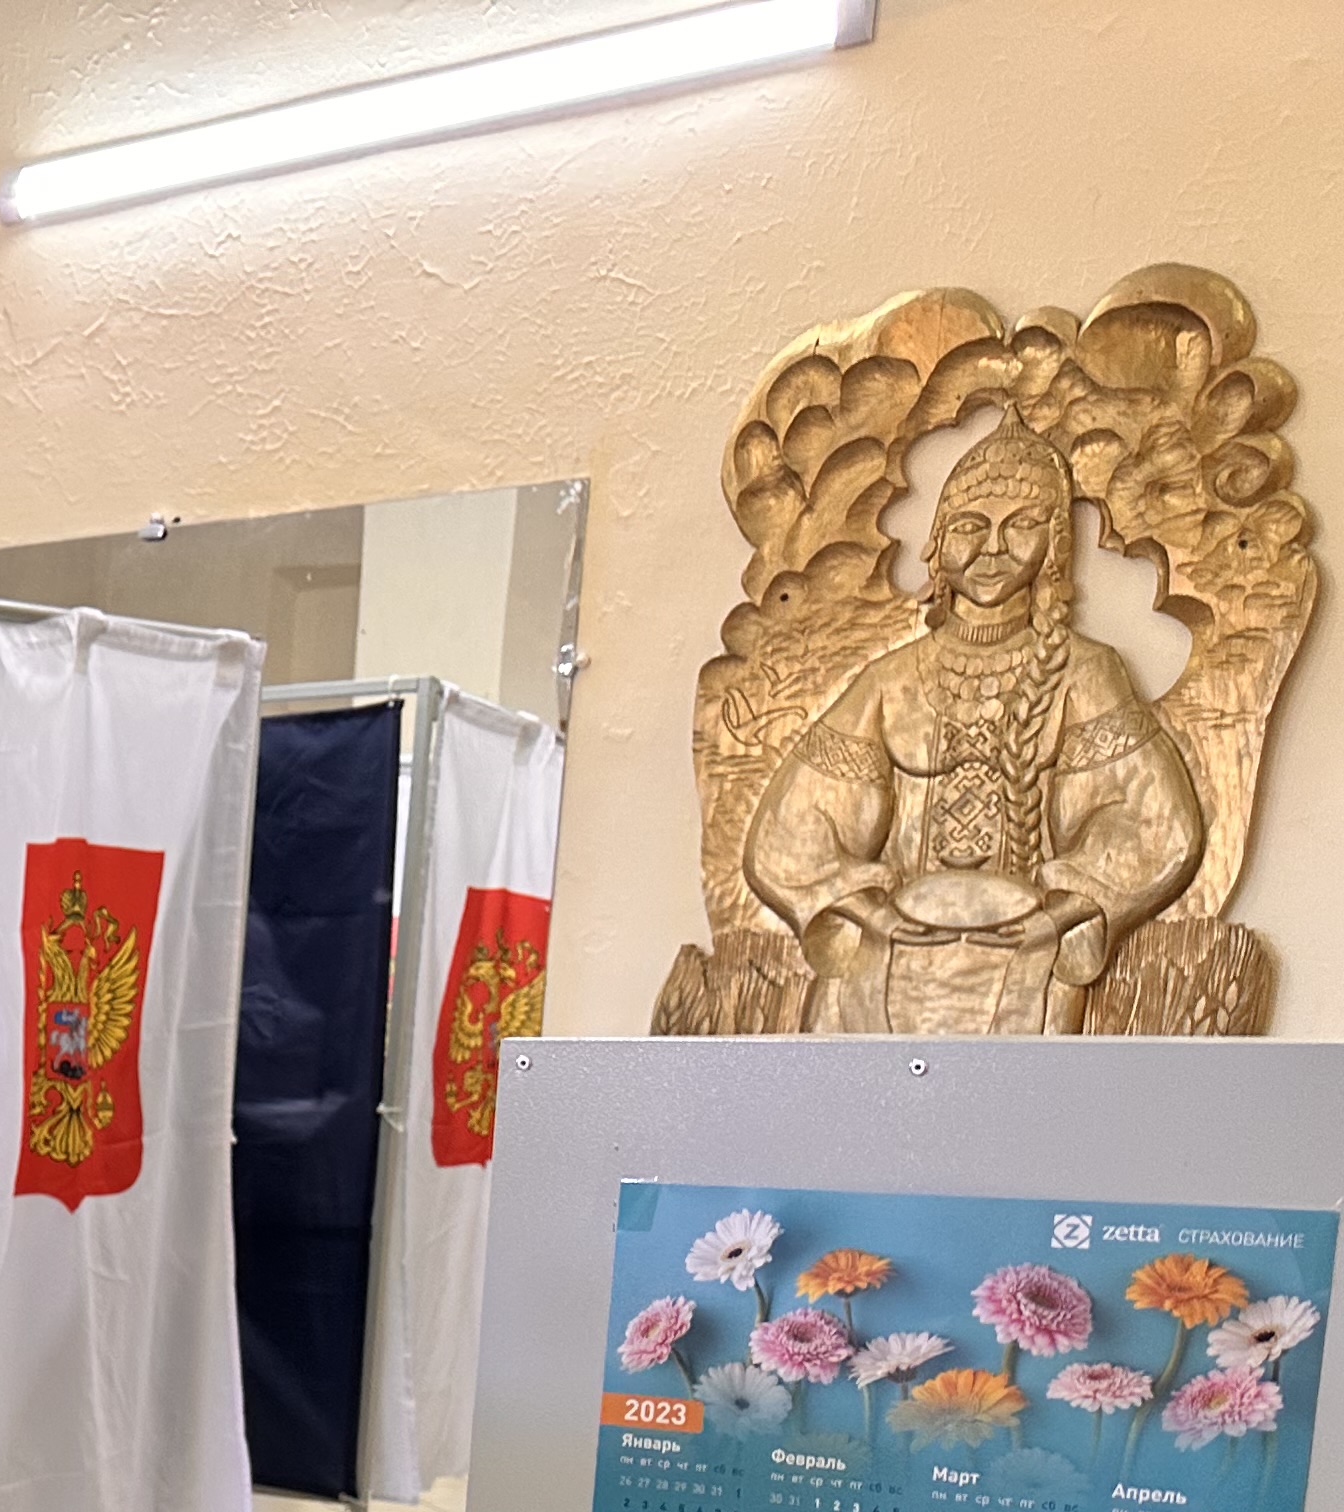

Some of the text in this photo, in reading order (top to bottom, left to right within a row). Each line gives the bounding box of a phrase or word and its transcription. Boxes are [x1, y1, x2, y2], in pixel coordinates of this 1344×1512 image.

[1102, 1223, 1161, 1242] zetta
[1178, 1228, 1305, 1249] СТРАХОВАНИЕ
[623, 1398, 688, 1427] 2023
[621, 1433, 681, 1454] Январь
[771, 1448, 846, 1472] Февраль
[932, 1466, 980, 1487] Март
[931, 1490, 947, 1501] пн
[954, 1493, 969, 1502] вт
[974, 1495, 990, 1507] ср
[997, 1497, 1013, 1507] чт
[1019, 1498, 1035, 1509] пт
[1112, 1483, 1187, 1506] Апрель
